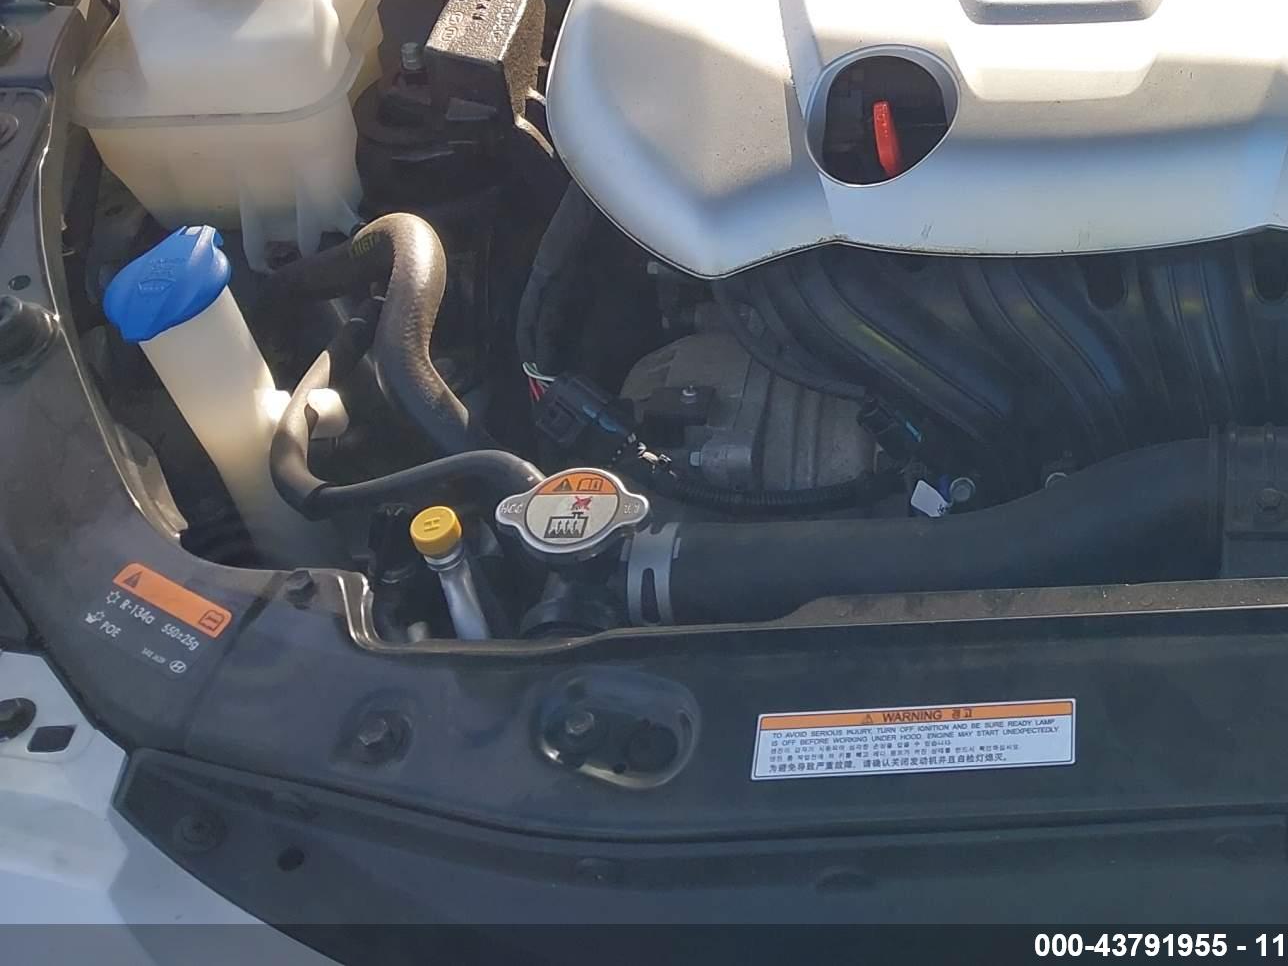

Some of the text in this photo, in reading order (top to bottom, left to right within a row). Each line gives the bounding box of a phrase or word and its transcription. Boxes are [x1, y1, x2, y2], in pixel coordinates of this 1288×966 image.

[119, 598, 156, 625] R-134a
[100, 620, 122, 638] POE
[882, 709, 943, 723] WARNING
[785, 731, 807, 739] AVOID
[811, 729, 843, 737] SERIOUS
[877, 726, 896, 735] TURN
[900, 725, 914, 734] OFF
[917, 723, 949, 732] IGNITION
[952, 722, 968, 731] AND
[971, 721, 980, 729] BE
[1007, 719, 1032, 728] READY
[1035, 718, 1056, 727] LAMP
[781, 739, 796, 747] OFF
[800, 738, 830, 746] BEFORE
[833, 736, 868, 745] WORKING
[871, 734, 897, 743] UNDER
[926, 731, 955, 740] ENGINE
[958, 730, 974, 739] MAY
[977, 729, 999, 737] START
